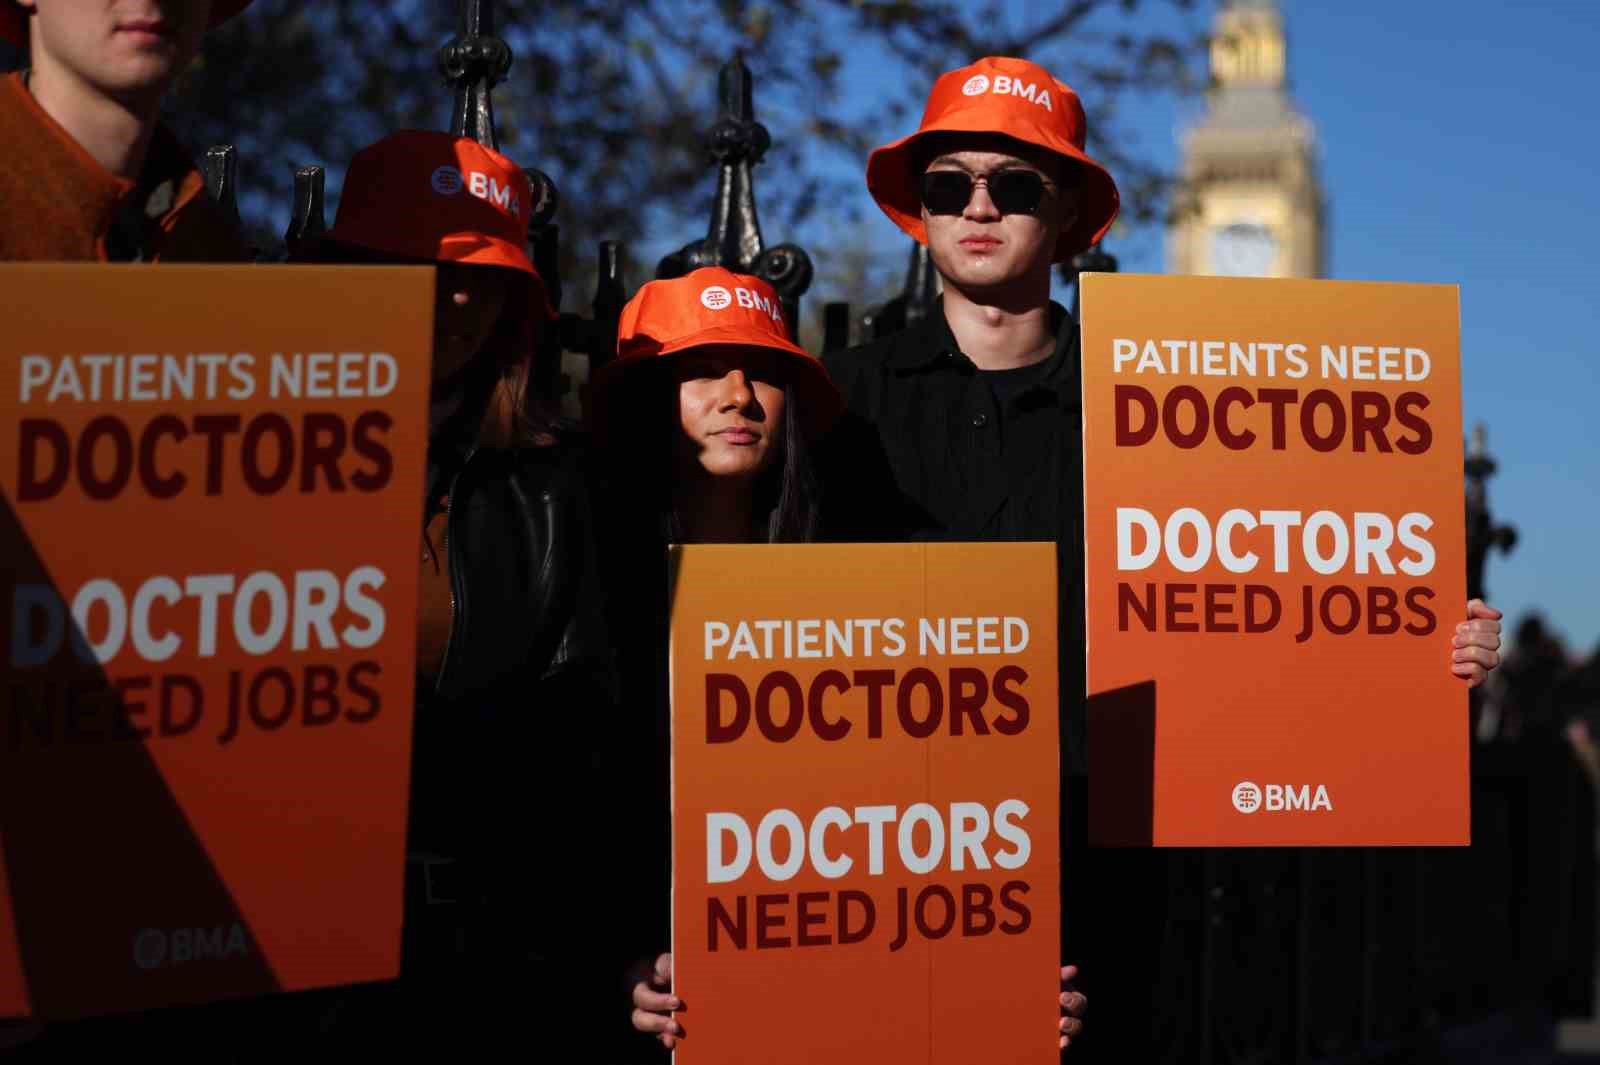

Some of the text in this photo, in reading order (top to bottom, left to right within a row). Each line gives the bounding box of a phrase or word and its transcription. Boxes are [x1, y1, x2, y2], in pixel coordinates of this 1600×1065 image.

[992, 75, 1053, 113] BMA
[734, 287, 783, 322] BMA
[19, 352, 399, 403] PATIENTS NEED
[1112, 338, 1431, 382] PATIENTS NEED
[1114, 384, 1434, 455] DOCTORS
[17, 410, 394, 503] DOCTORS
[1116, 507, 1436, 577] DOCTORS
[9, 565, 387, 668] DOCTORS
[703, 616, 1030, 661] PATIENTS NEED
[1117, 582, 1437, 644] NEED JOBS
[7, 660, 383, 751] NEED JOBS
[705, 665, 1031, 745] DOCTORS
[1265, 784, 1333, 812] BMA
[706, 799, 1032, 884] DOCTORS
[171, 922, 249, 962] BMA
[707, 880, 1032, 953] NEED JOBS
